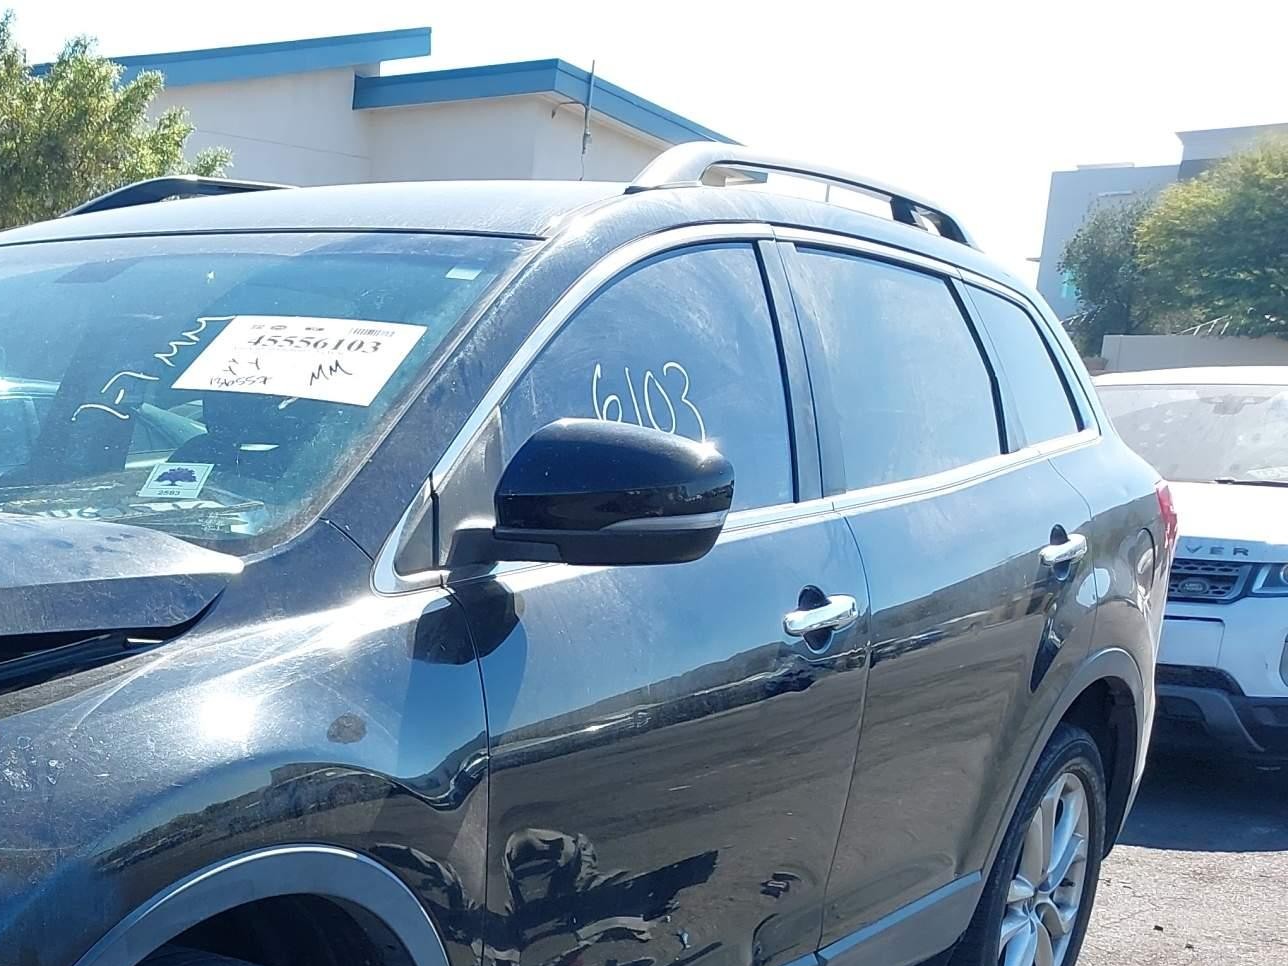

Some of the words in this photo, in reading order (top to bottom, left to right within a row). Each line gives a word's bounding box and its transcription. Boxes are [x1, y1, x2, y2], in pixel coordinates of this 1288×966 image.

[247, 333, 383, 355] 45556103
[591, 360, 707, 443] 6103
[1184, 544, 1250, 557] VER
